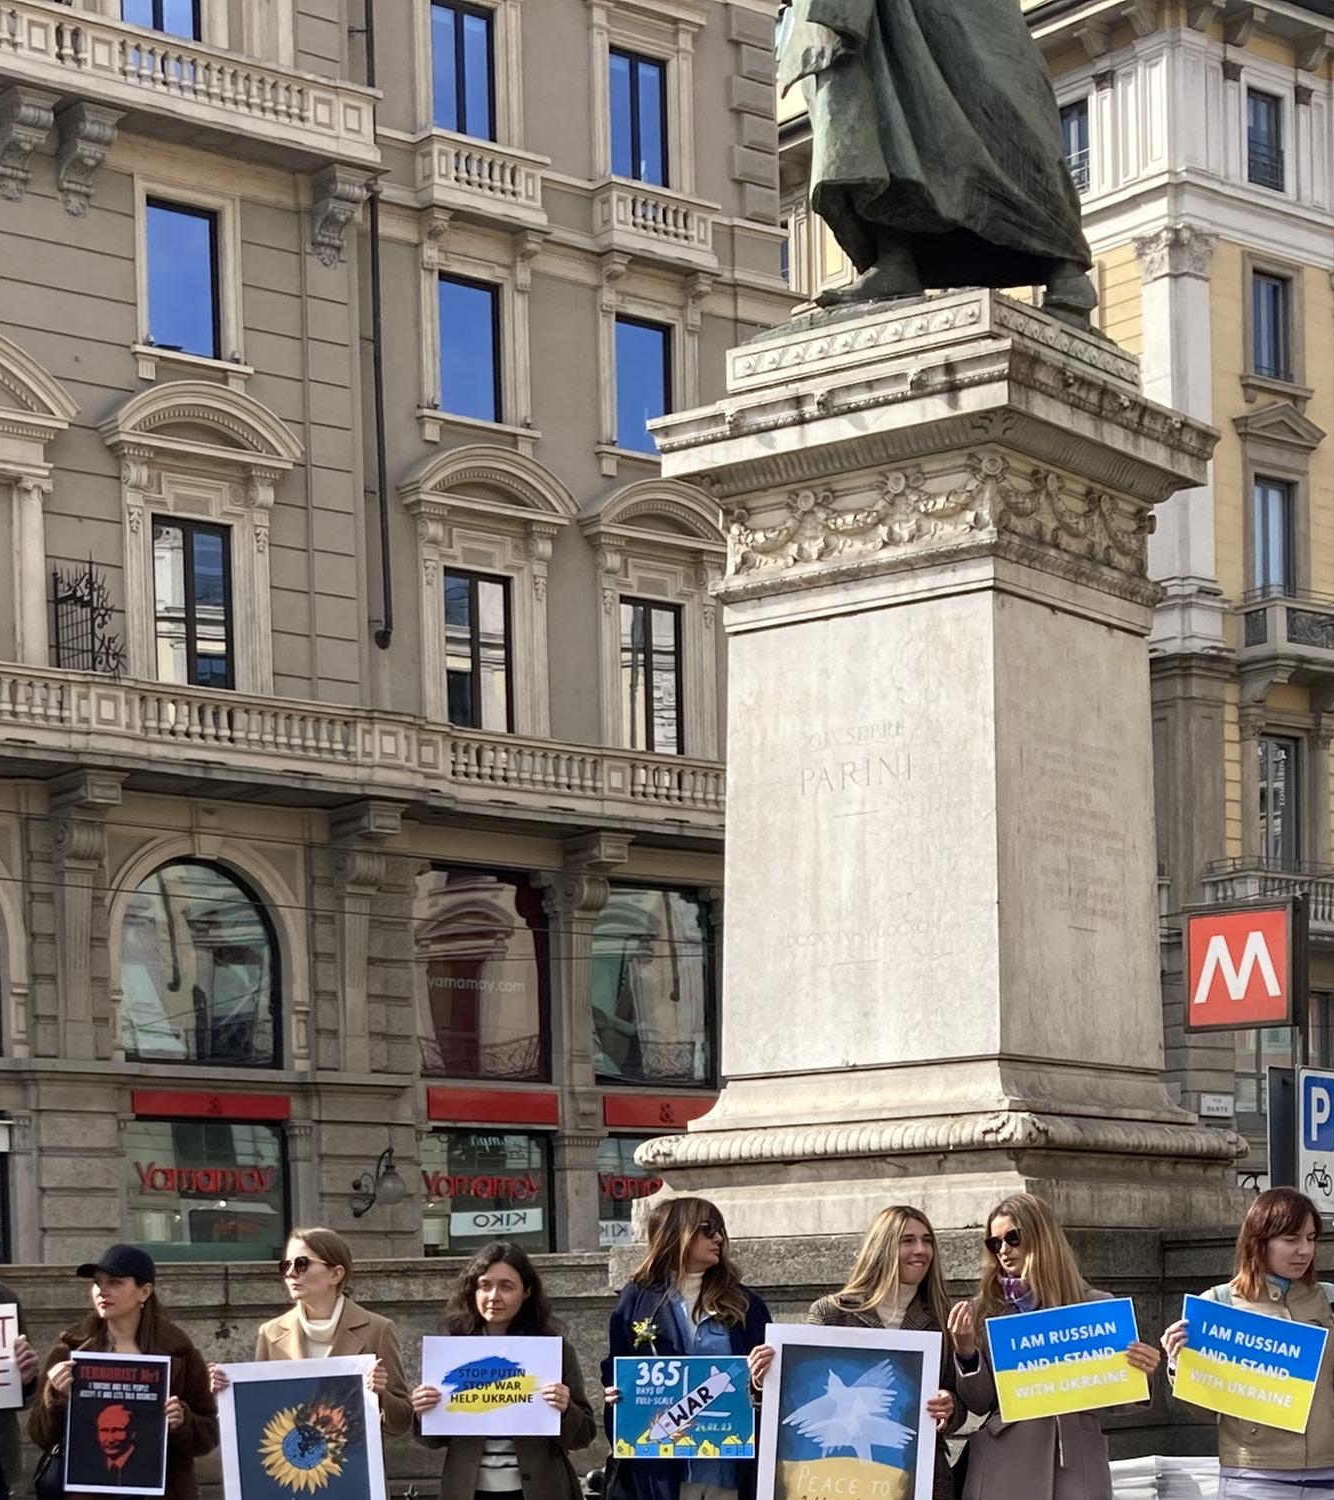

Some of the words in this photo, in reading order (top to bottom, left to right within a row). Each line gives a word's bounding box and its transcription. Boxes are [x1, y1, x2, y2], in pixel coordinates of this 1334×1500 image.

[801, 753, 912, 796] PARINI
[1194, 930, 1282, 1005] M
[428, 977, 525, 993] yamamay.com
[1310, 1086, 1331, 1142] P
[1011, 1337, 1016, 1352] I
[1020, 1334, 1046, 1350] AM
[1049, 1321, 1117, 1344] RUSSIAN
[1202, 1320, 1207, 1335] I
[1209, 1324, 1232, 1341] AM
[1234, 1332, 1301, 1359] RUSSIAN
[80, 1366, 137, 1381] TERRORIST
[458, 1368, 487, 1378] STOP
[490, 1368, 526, 1378] PUTIN
[635, 1360, 682, 1387] 365
[1016, 1357, 1049, 1374] AND
[1055, 1355, 1060, 1367] I
[1064, 1346, 1116, 1364] STAND
[1197, 1346, 1229, 1363] AND
[1239, 1356, 1290, 1380] STAND
[450, 1394, 479, 1404] HELP
[482, 1394, 534, 1404] UKRAINE
[462, 1381, 491, 1391] STOP
[494, 1381, 521, 1391] WAR
[635, 1386, 654, 1395] DAYS
[655, 1386, 666, 1395] OF
[1014, 1382, 1055, 1400] WITH
[1059, 1369, 1129, 1393] UKRAINE
[1189, 1370, 1224, 1389] WITH
[1227, 1381, 1294, 1408] UKRAINE
[668, 1386, 714, 1427] WAR
[796, 1465, 860, 1495] PEACE
[872, 1479, 891, 1497] TO
